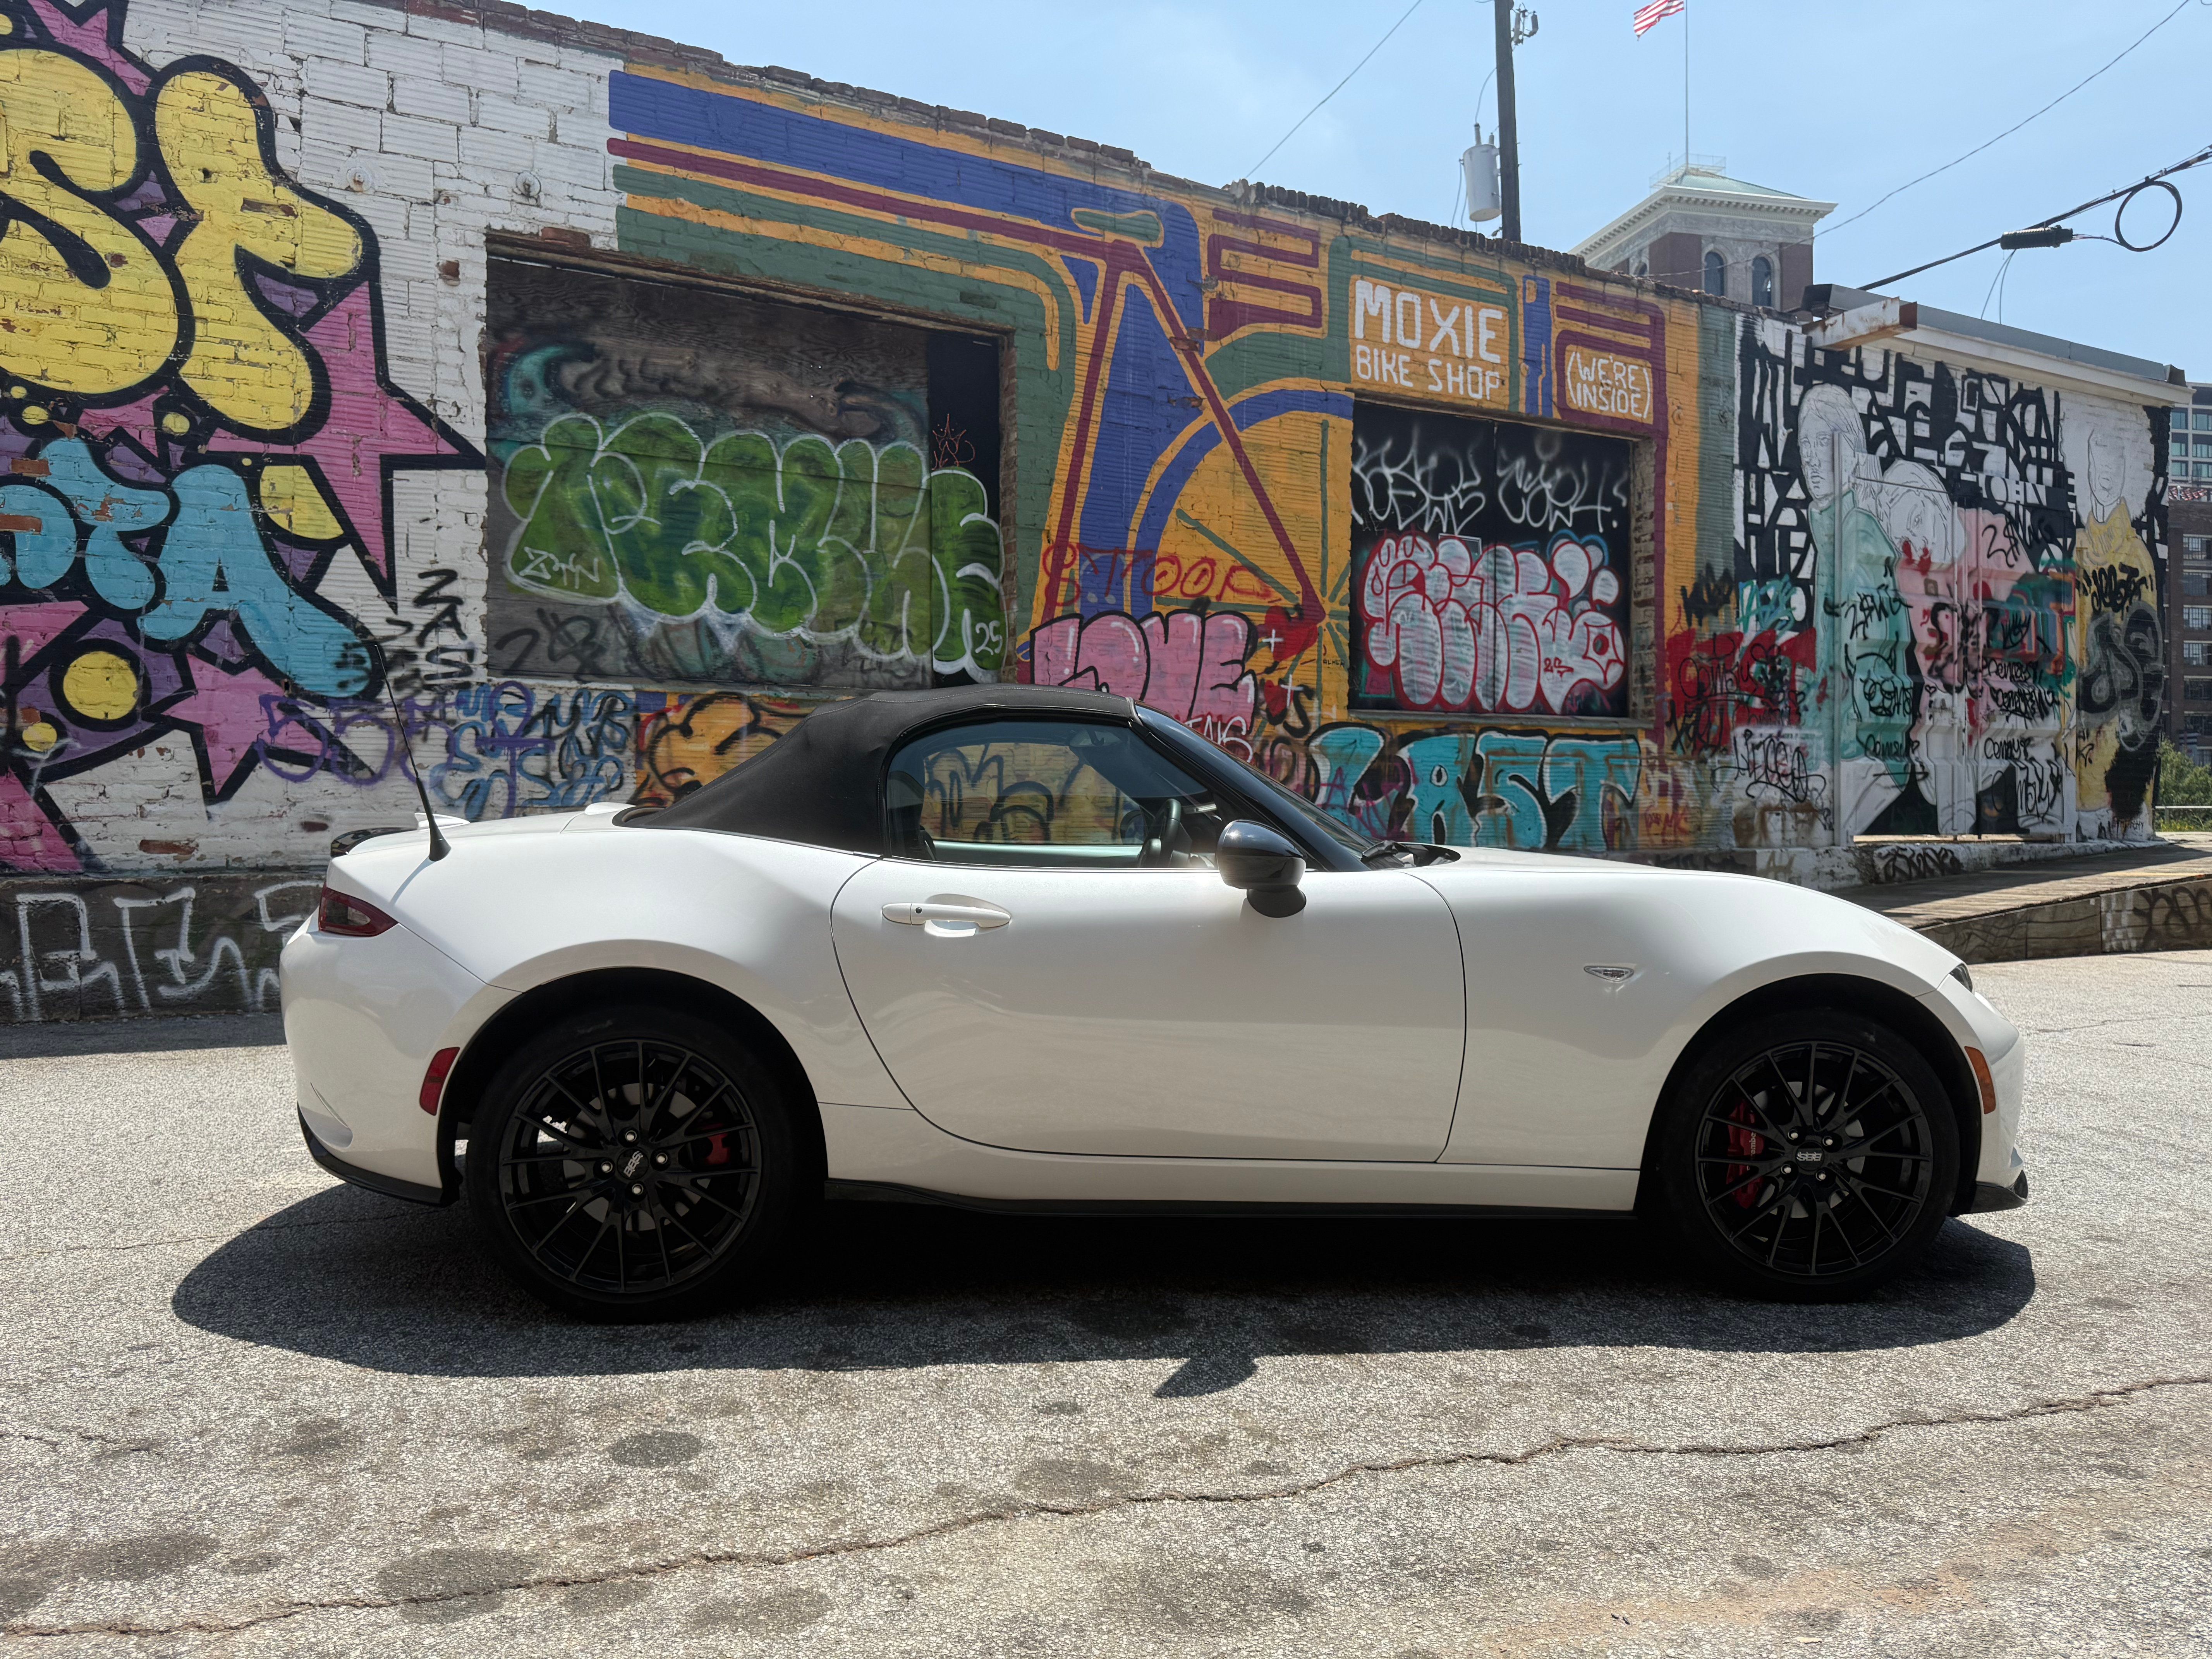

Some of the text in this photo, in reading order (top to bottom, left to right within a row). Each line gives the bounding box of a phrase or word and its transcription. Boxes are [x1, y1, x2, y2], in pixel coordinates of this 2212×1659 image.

[1355, 280, 1503, 364] MOXIE
[1356, 345, 1500, 400] BIKE SHOP
[975, 620, 1003, 656] 25
[623, 1150, 644, 1178] BBS
[1796, 1151, 1822, 1161] BBS
